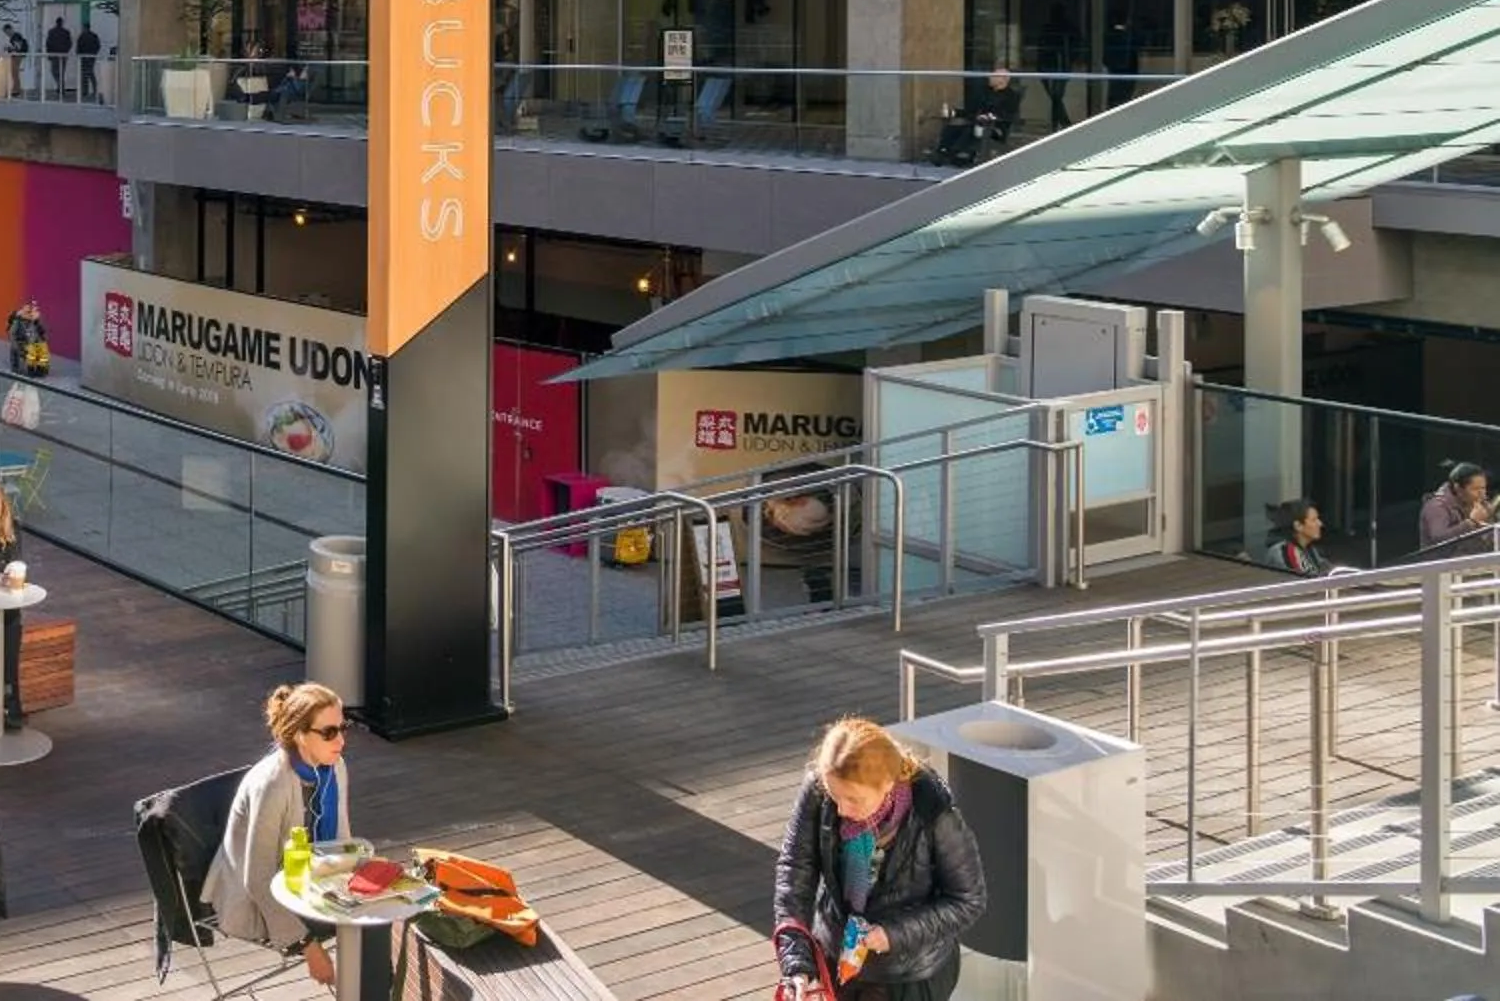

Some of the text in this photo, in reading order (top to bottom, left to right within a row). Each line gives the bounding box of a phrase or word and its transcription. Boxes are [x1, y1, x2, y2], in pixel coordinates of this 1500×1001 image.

[137, 301, 373, 389] MARUGAME UDON
[743, 412, 863, 437] MARUG
[743, 435, 795, 452] UDON
